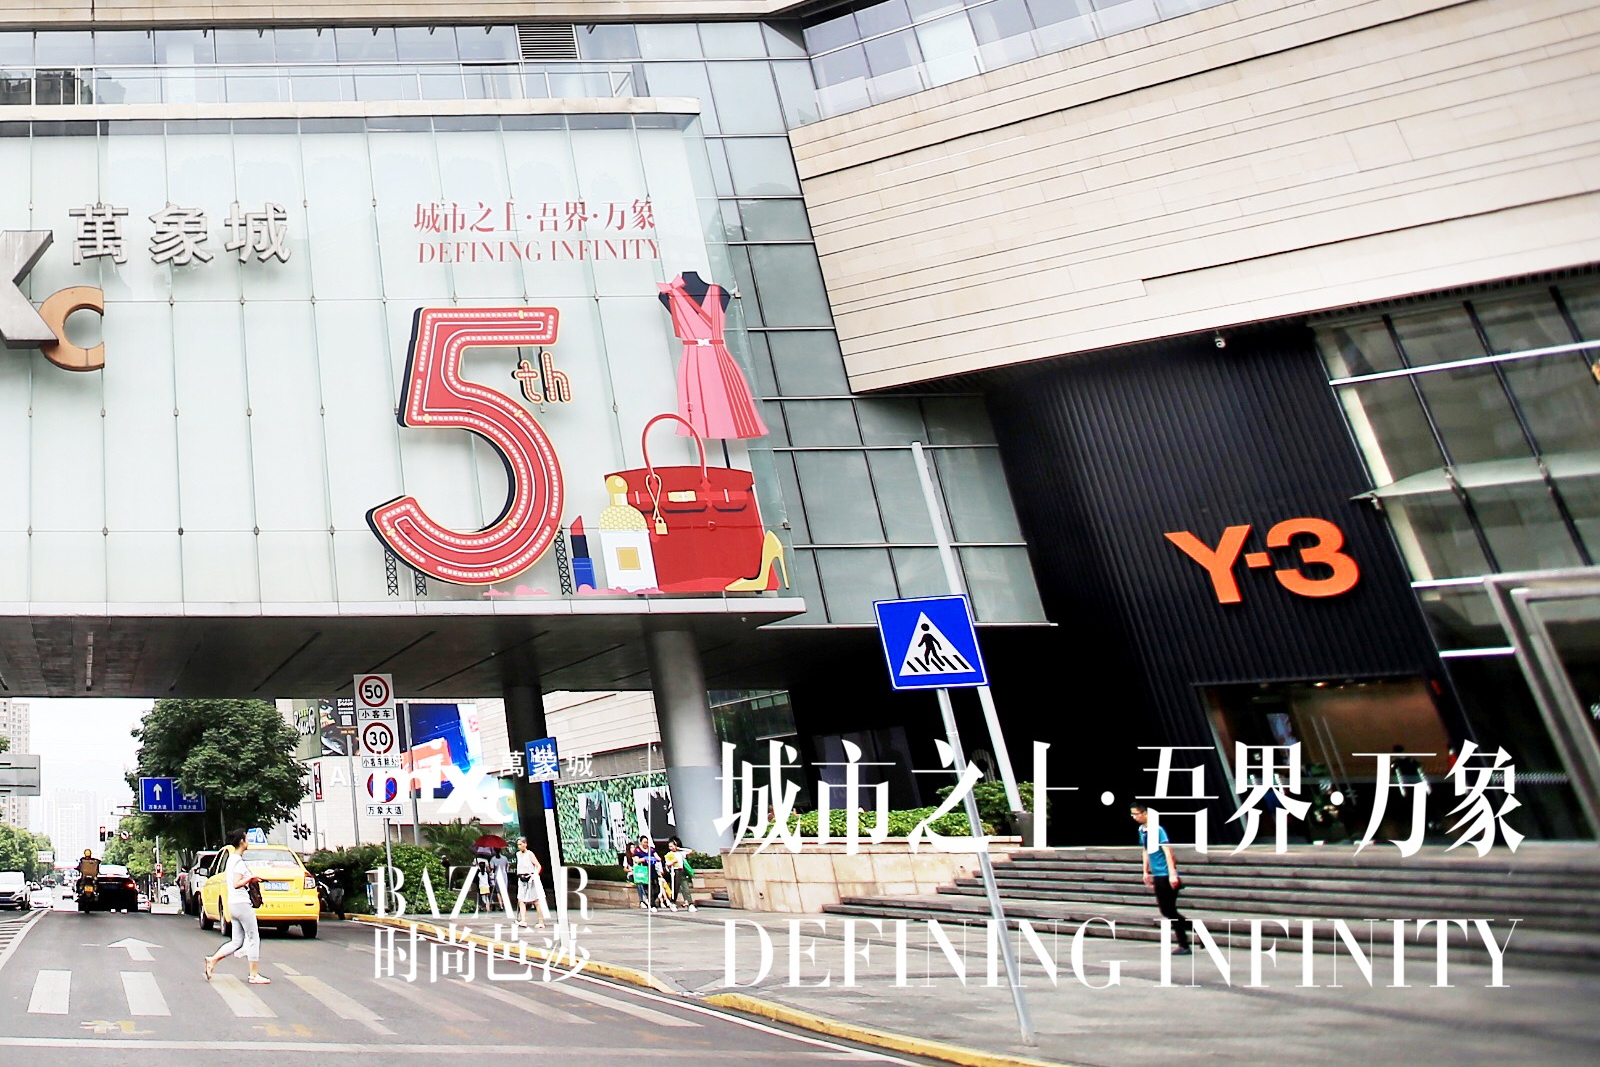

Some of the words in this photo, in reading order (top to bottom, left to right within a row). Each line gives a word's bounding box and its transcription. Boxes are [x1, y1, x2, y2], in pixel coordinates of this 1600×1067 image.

[413, 199, 655, 234] 城市之上·吾界·万象
[69, 202, 292, 267] 萬象城
[417, 241, 542, 264] DEFINING
[550, 238, 662, 262] INFINITY
[1164, 517, 1362, 605] Y-3
[364, 684, 383, 700] 50
[361, 710, 391, 720] 小客车
[369, 731, 388, 746] 30
[367, 806, 403, 816] 万象大道
